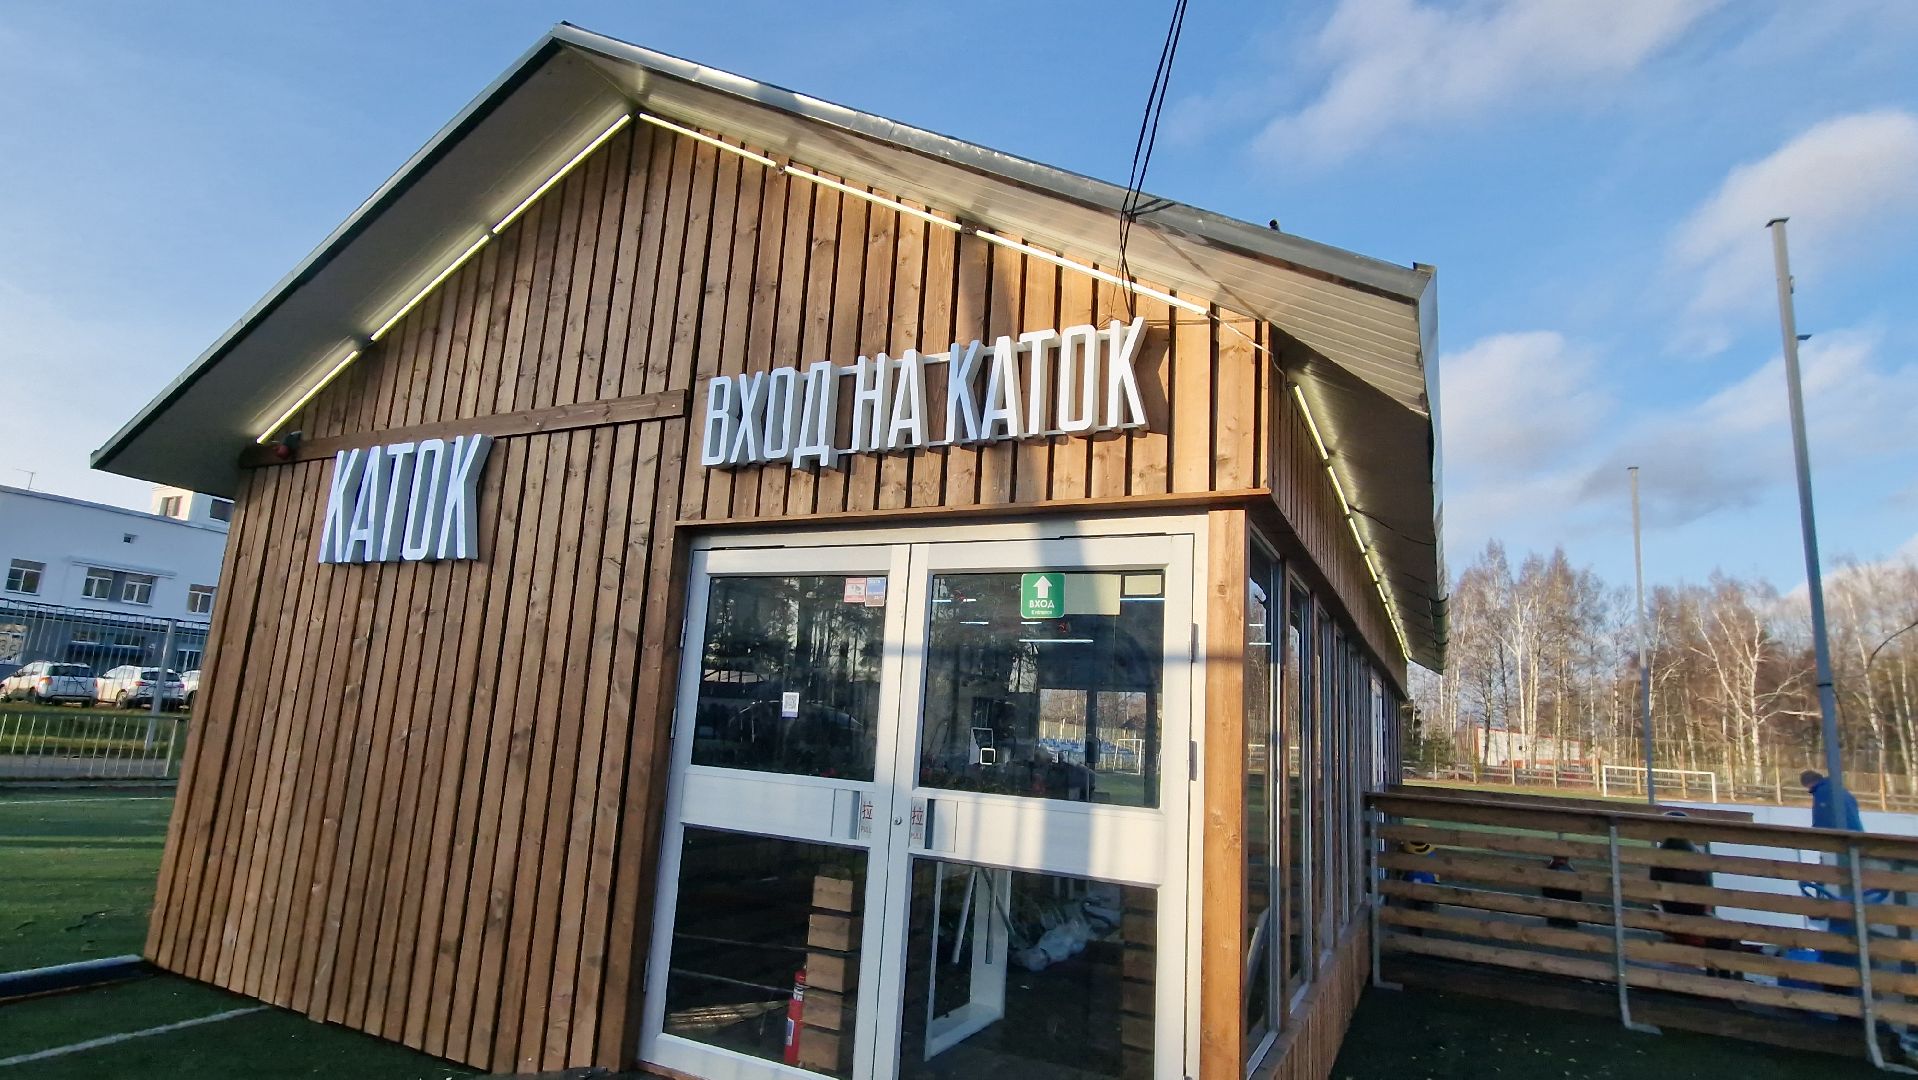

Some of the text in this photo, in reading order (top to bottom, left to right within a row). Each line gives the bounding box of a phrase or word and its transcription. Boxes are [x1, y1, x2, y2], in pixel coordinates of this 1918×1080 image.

[701, 317, 1148, 469] ВХОД НА КАТОК
[318, 433, 486, 564] КАТОК
[1029, 600, 1055, 608] ВХОД
[862, 801, 873, 820] 拉
[912, 806, 923, 825] 拉
